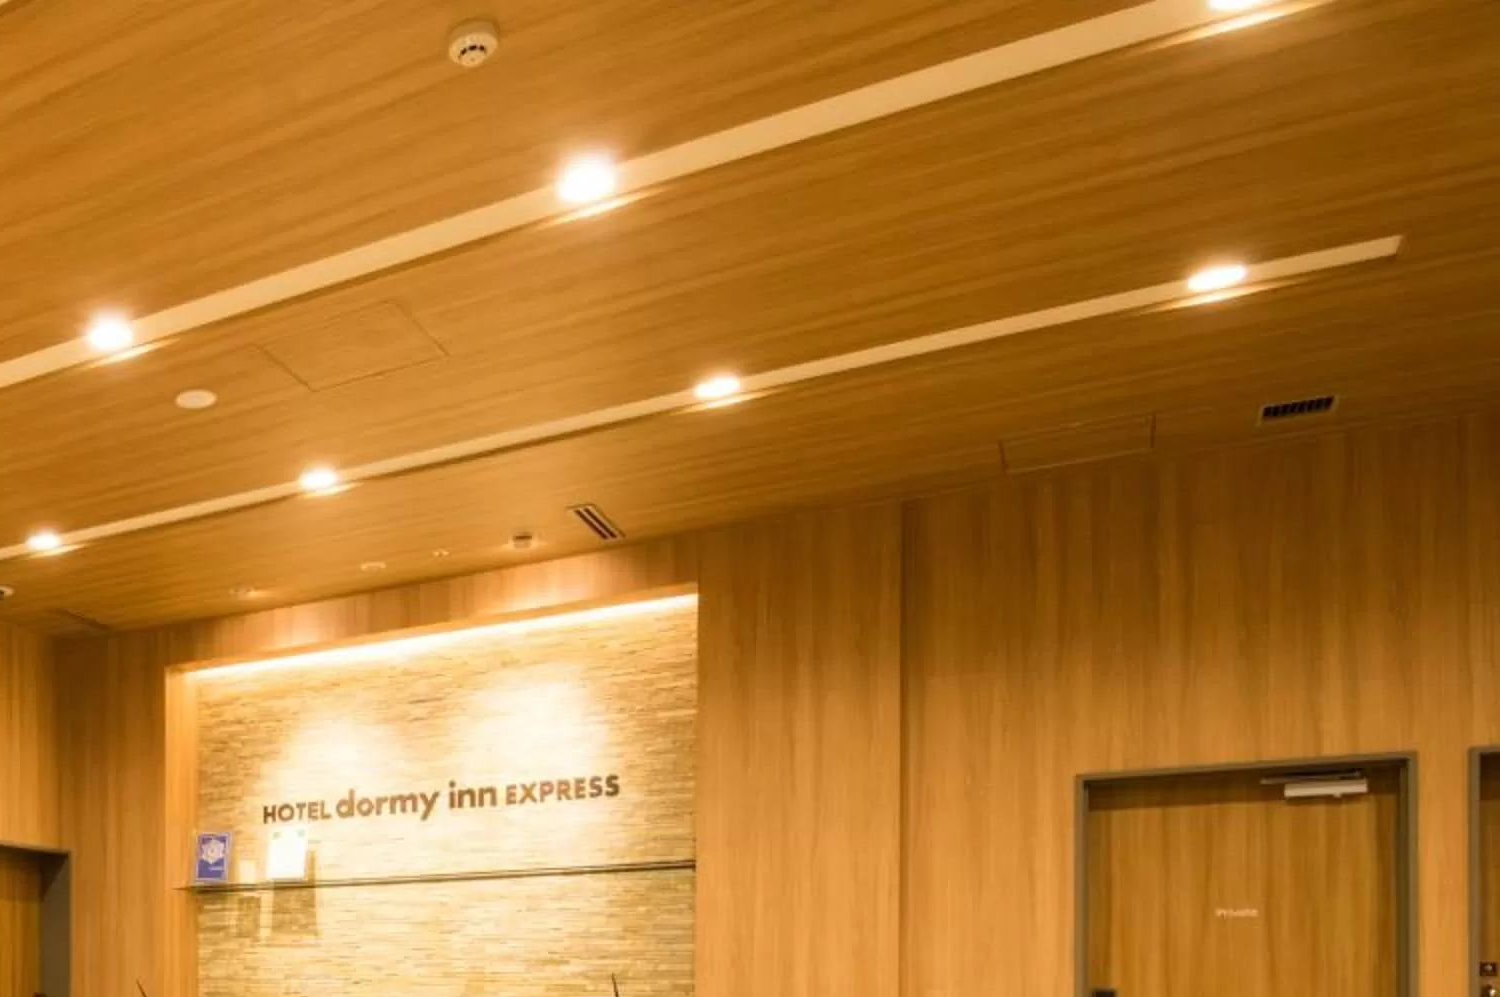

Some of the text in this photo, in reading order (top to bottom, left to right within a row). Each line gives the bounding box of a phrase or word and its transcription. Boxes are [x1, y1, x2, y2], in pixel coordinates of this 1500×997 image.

[263, 774, 620, 824] HOTEL dormy inn EXPRESS
